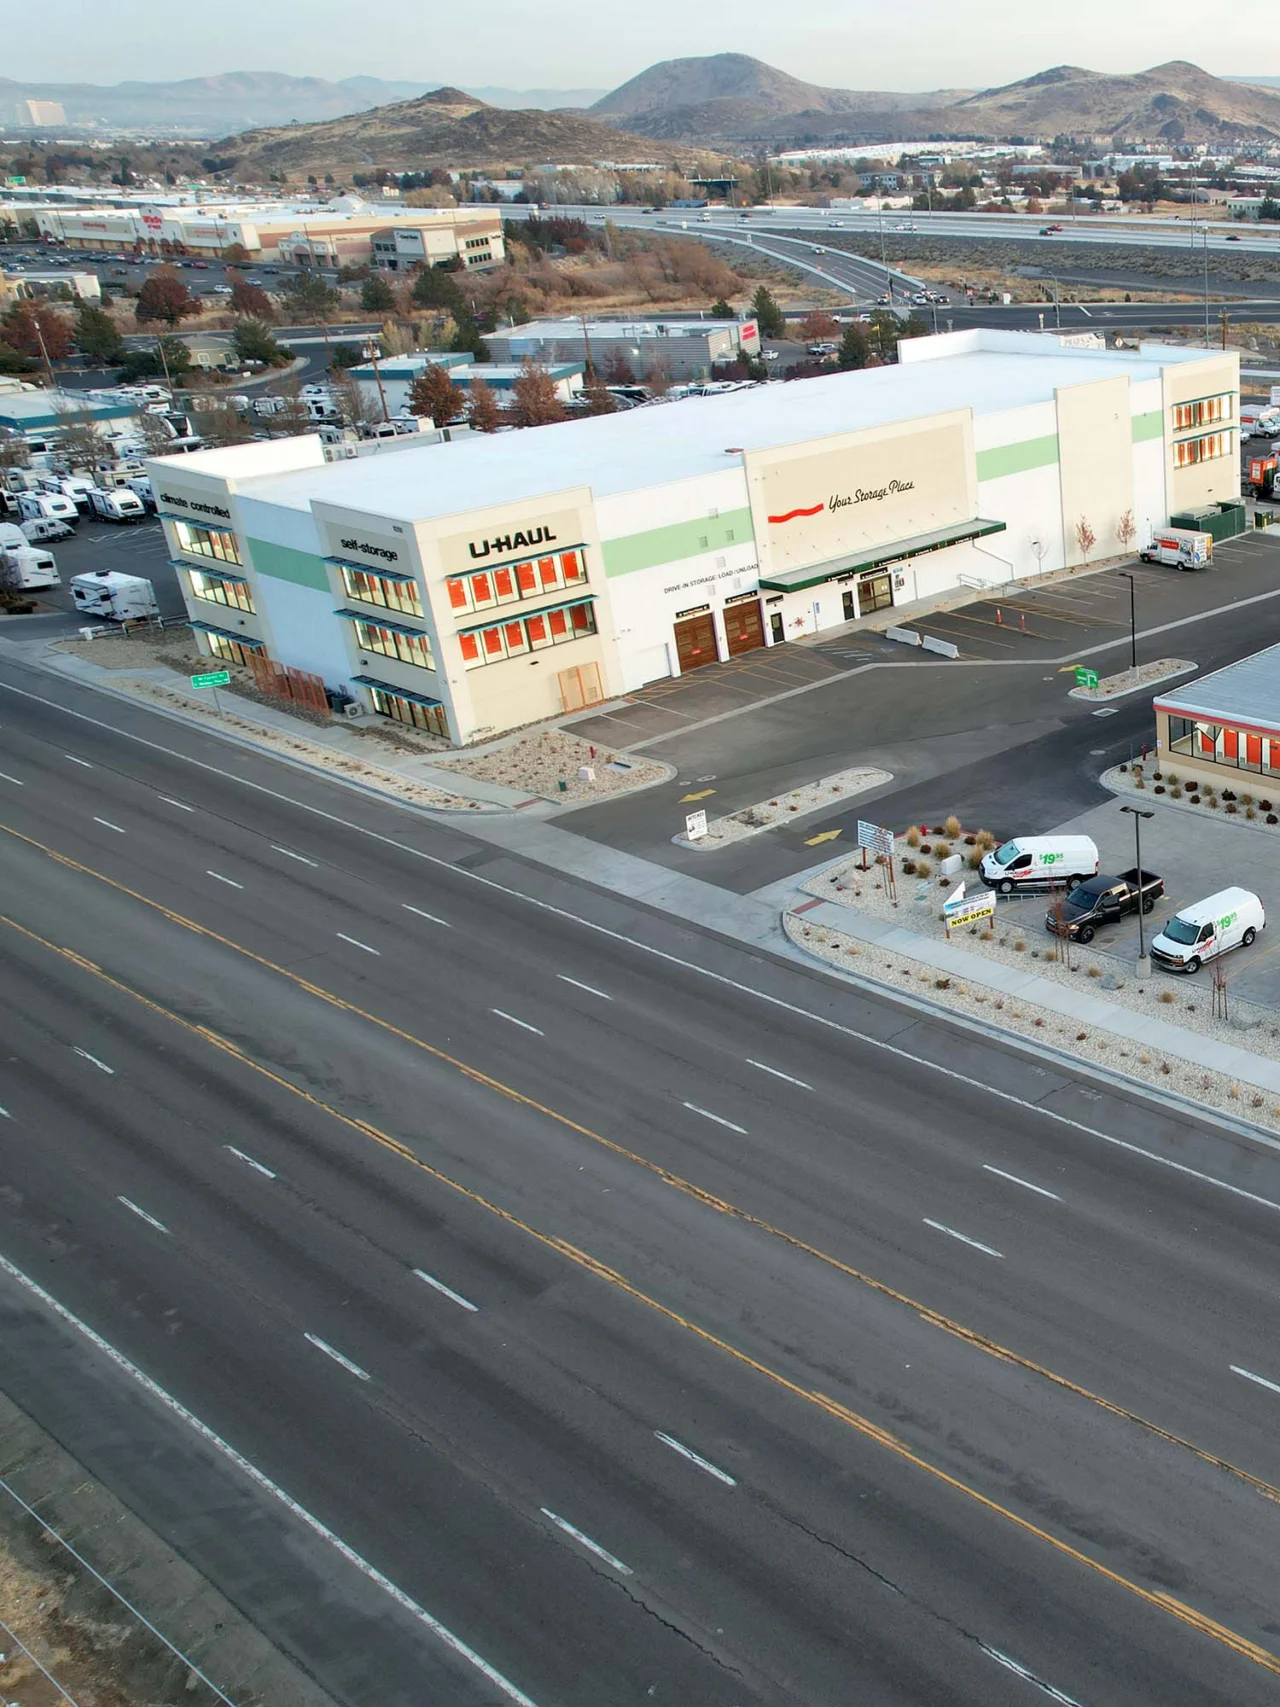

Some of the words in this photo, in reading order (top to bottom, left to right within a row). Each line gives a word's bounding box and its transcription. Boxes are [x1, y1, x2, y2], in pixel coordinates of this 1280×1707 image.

[160, 493, 189, 508] climate
[190, 501, 231, 519] controlled
[828, 494, 853, 513] Your
[853, 488, 889, 504] Storage
[888, 479, 915, 494] Place
[341, 539, 398, 562] self-storage
[469, 526, 557, 558] U-HAUL
[664, 581, 689, 594] DRIVE-IN
[717, 570, 734, 579] LOAD
[951, 916, 970, 927] NOW
[970, 908, 992, 920] OPEN
